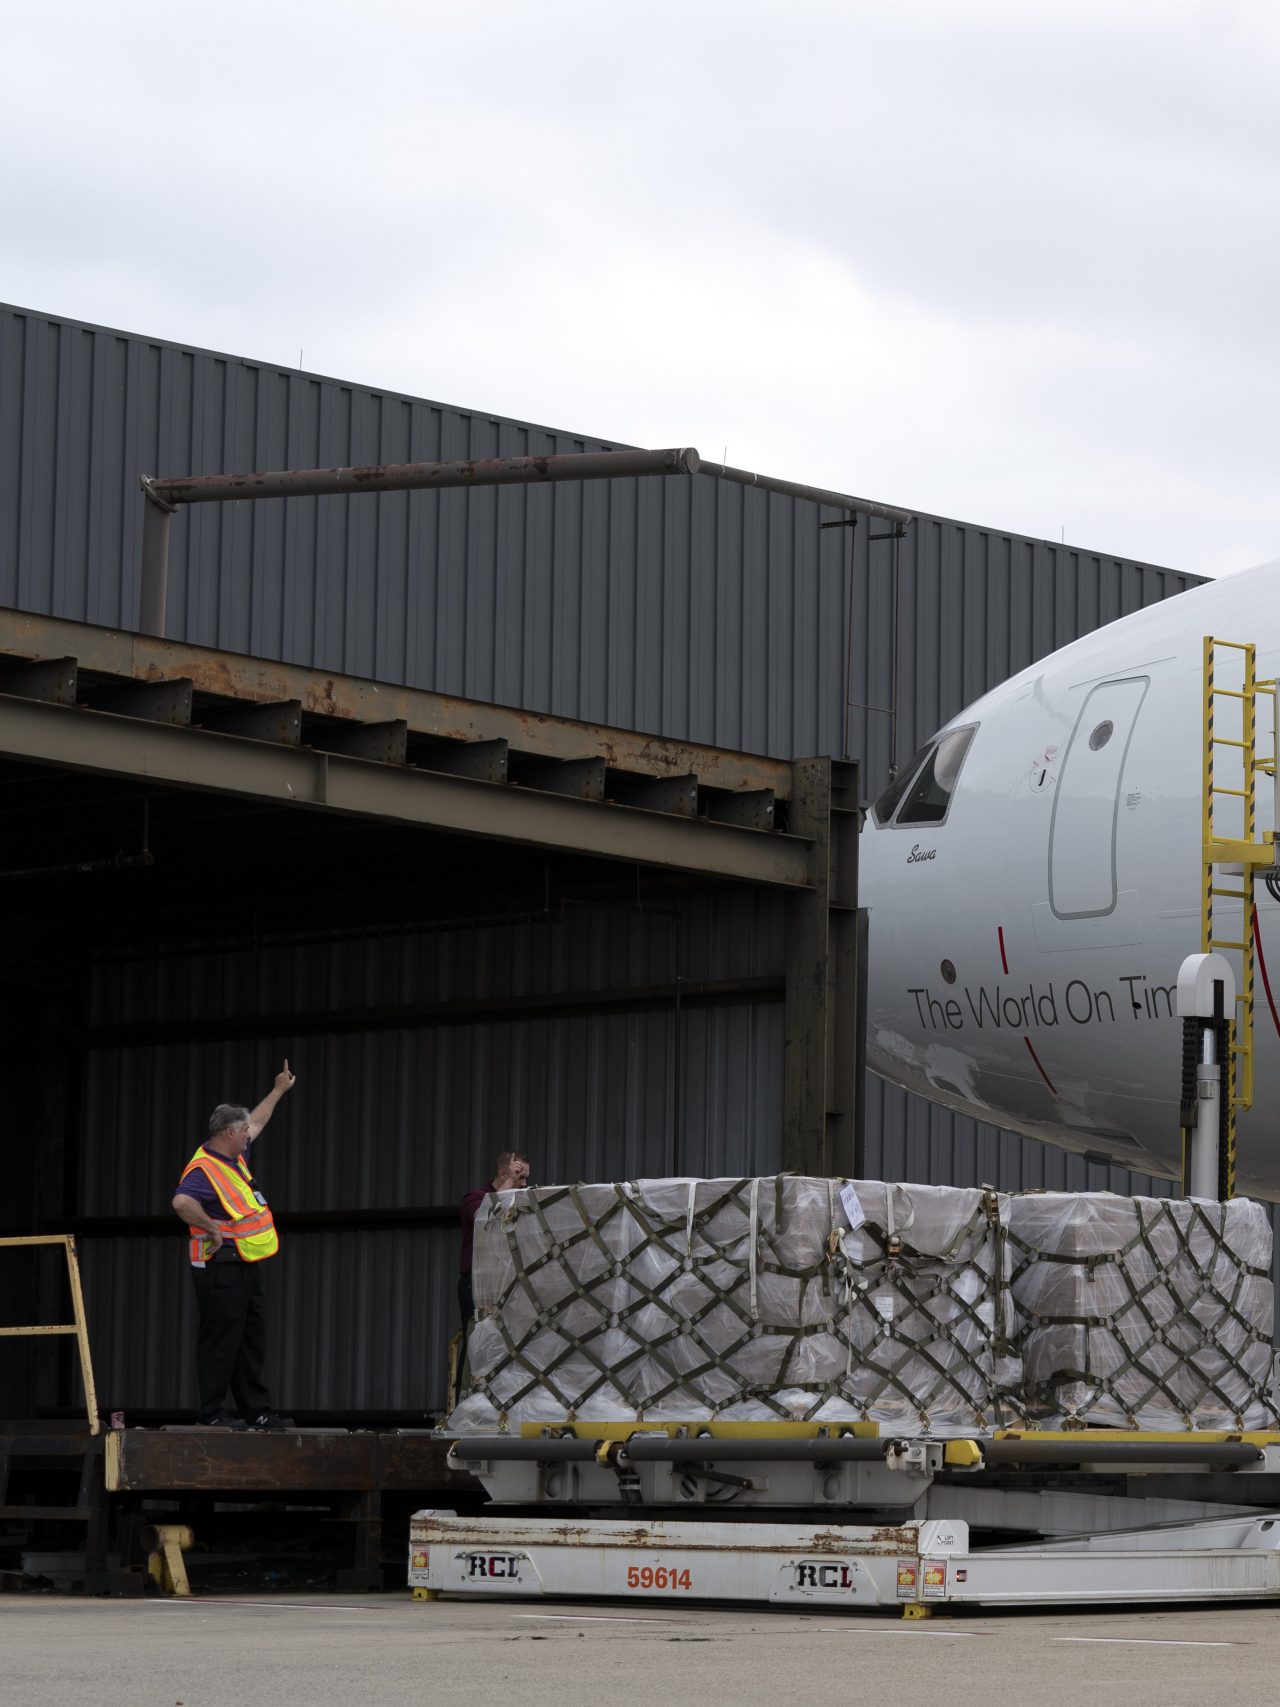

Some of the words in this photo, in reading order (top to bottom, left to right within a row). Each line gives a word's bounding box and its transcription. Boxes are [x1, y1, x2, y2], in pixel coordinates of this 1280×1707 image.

[907, 844, 936, 864] Sawa
[907, 988, 963, 1030] The
[965, 982, 1059, 1028] World
[1065, 979, 1116, 1024] On
[1119, 975, 1178, 1020] Tim
[469, 1556, 519, 1577] RCL
[627, 1566, 692, 1590] 59614
[797, 1565, 852, 1588] RCL
